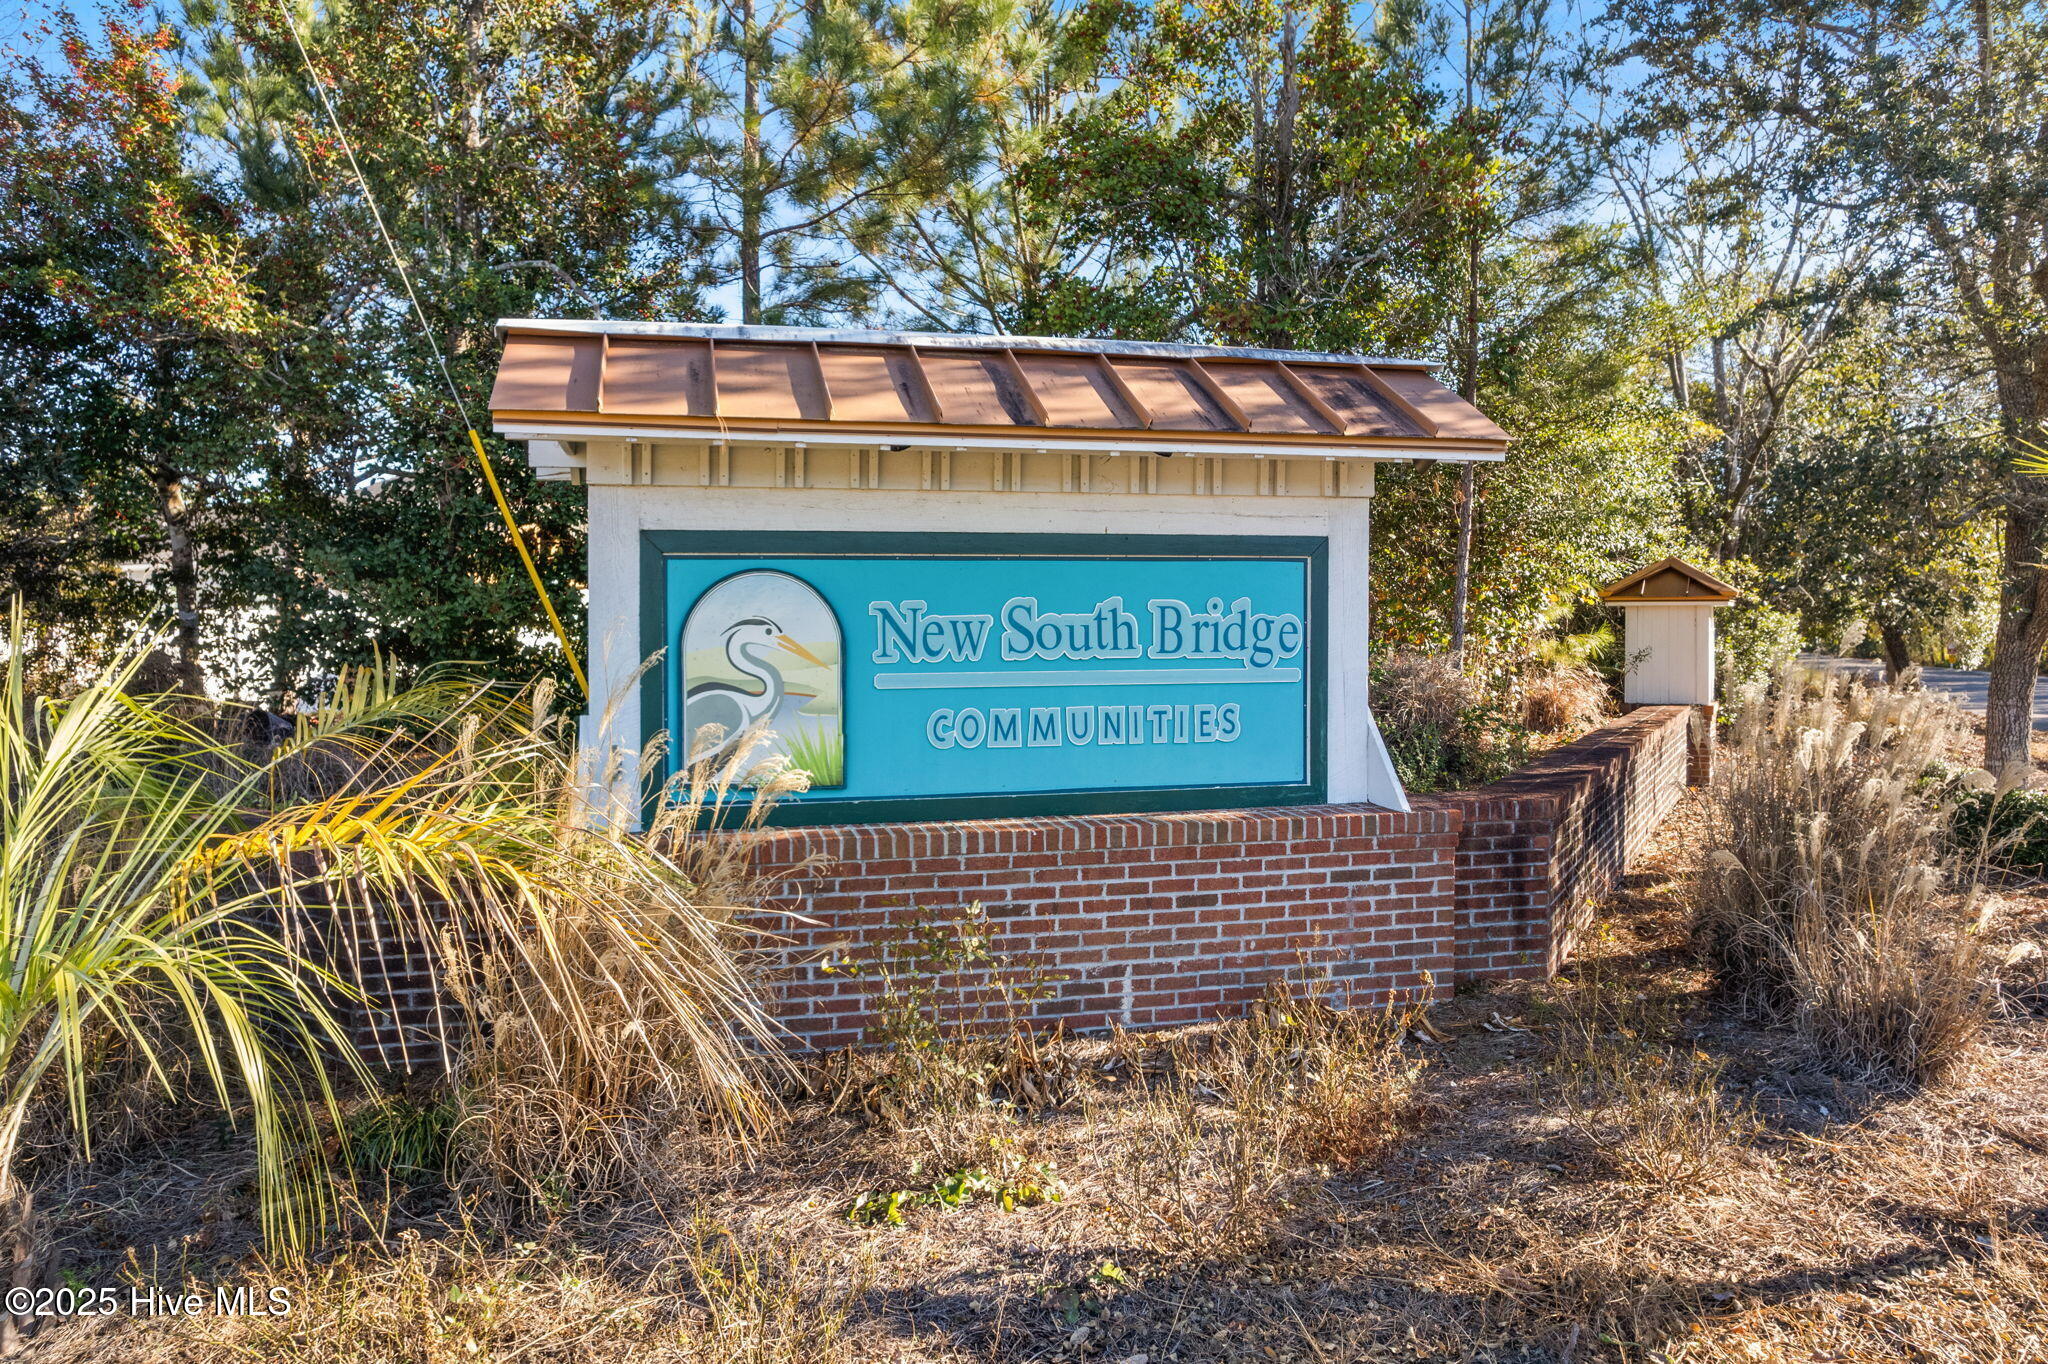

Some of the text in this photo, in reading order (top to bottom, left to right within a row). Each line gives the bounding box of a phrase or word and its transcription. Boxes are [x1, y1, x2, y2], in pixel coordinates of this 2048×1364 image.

[872, 600, 1301, 668] New South Bridge
[930, 705, 1238, 746] COMMUNITIES
